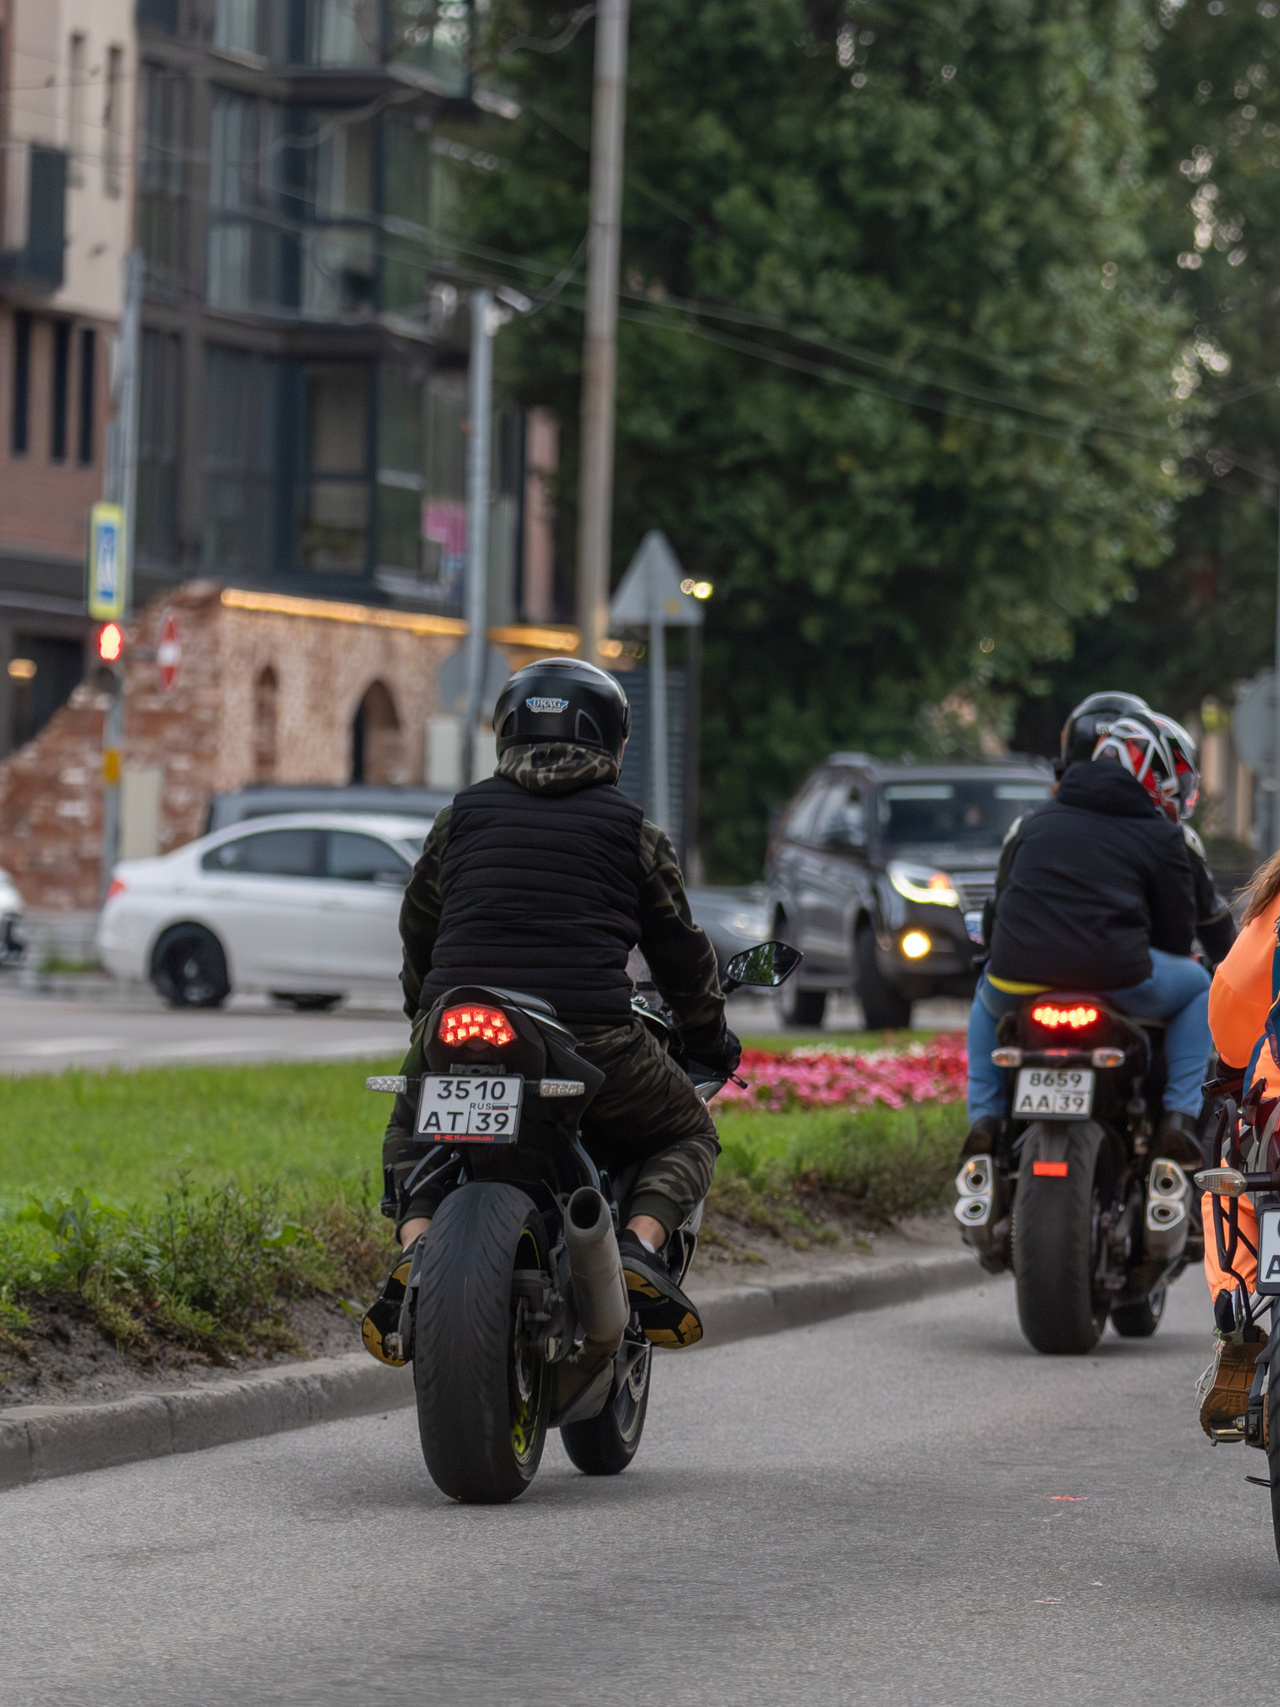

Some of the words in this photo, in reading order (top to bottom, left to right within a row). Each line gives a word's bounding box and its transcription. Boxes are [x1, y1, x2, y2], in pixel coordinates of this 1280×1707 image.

[533, 699, 561, 708] DRAG
[1029, 1072, 1082, 1088] 8659
[437, 1080, 506, 1101] 3510
[469, 1102, 492, 1111] RUS
[1020, 1094, 1050, 1112] AA
[1058, 1096, 1084, 1113] 39
[422, 1111, 464, 1131] AT
[475, 1112, 509, 1132] 39
